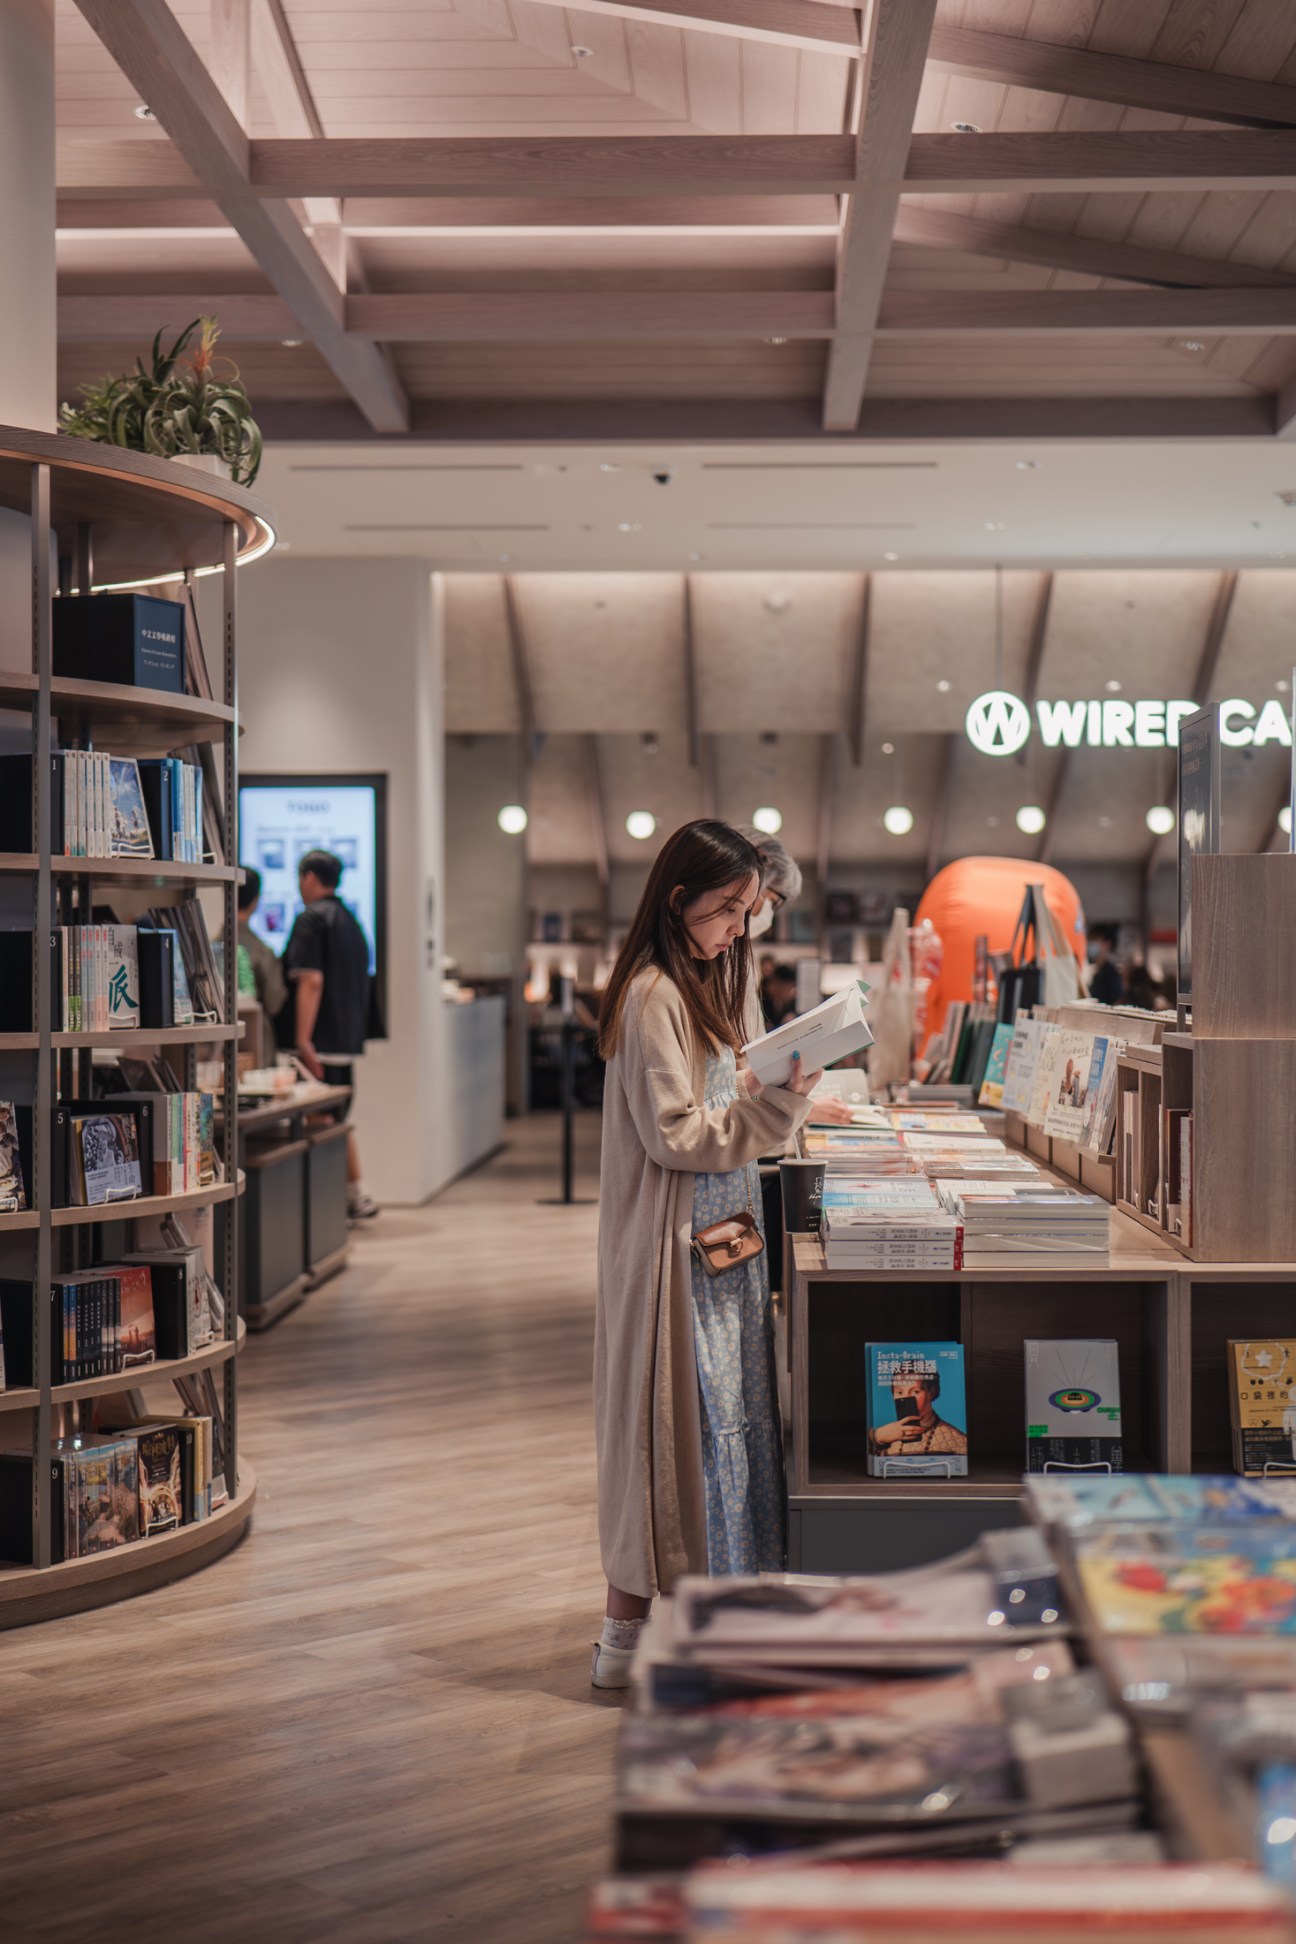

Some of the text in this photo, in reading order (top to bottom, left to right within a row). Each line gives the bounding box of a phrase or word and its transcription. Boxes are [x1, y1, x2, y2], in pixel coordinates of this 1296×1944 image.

[52, 759, 57, 770] 1
[163, 770, 169, 781] 2
[50, 936, 56, 947] 3
[164, 938, 169, 949] 4
[142, 1106, 148, 1116] 6
[57, 1112, 64, 1124] 5
[50, 1290, 56, 1302] 7
[877, 1360, 937, 1374] 拯救手機腦
[186, 1433, 192, 1444] 10
[51, 1467, 58, 1479] 9
